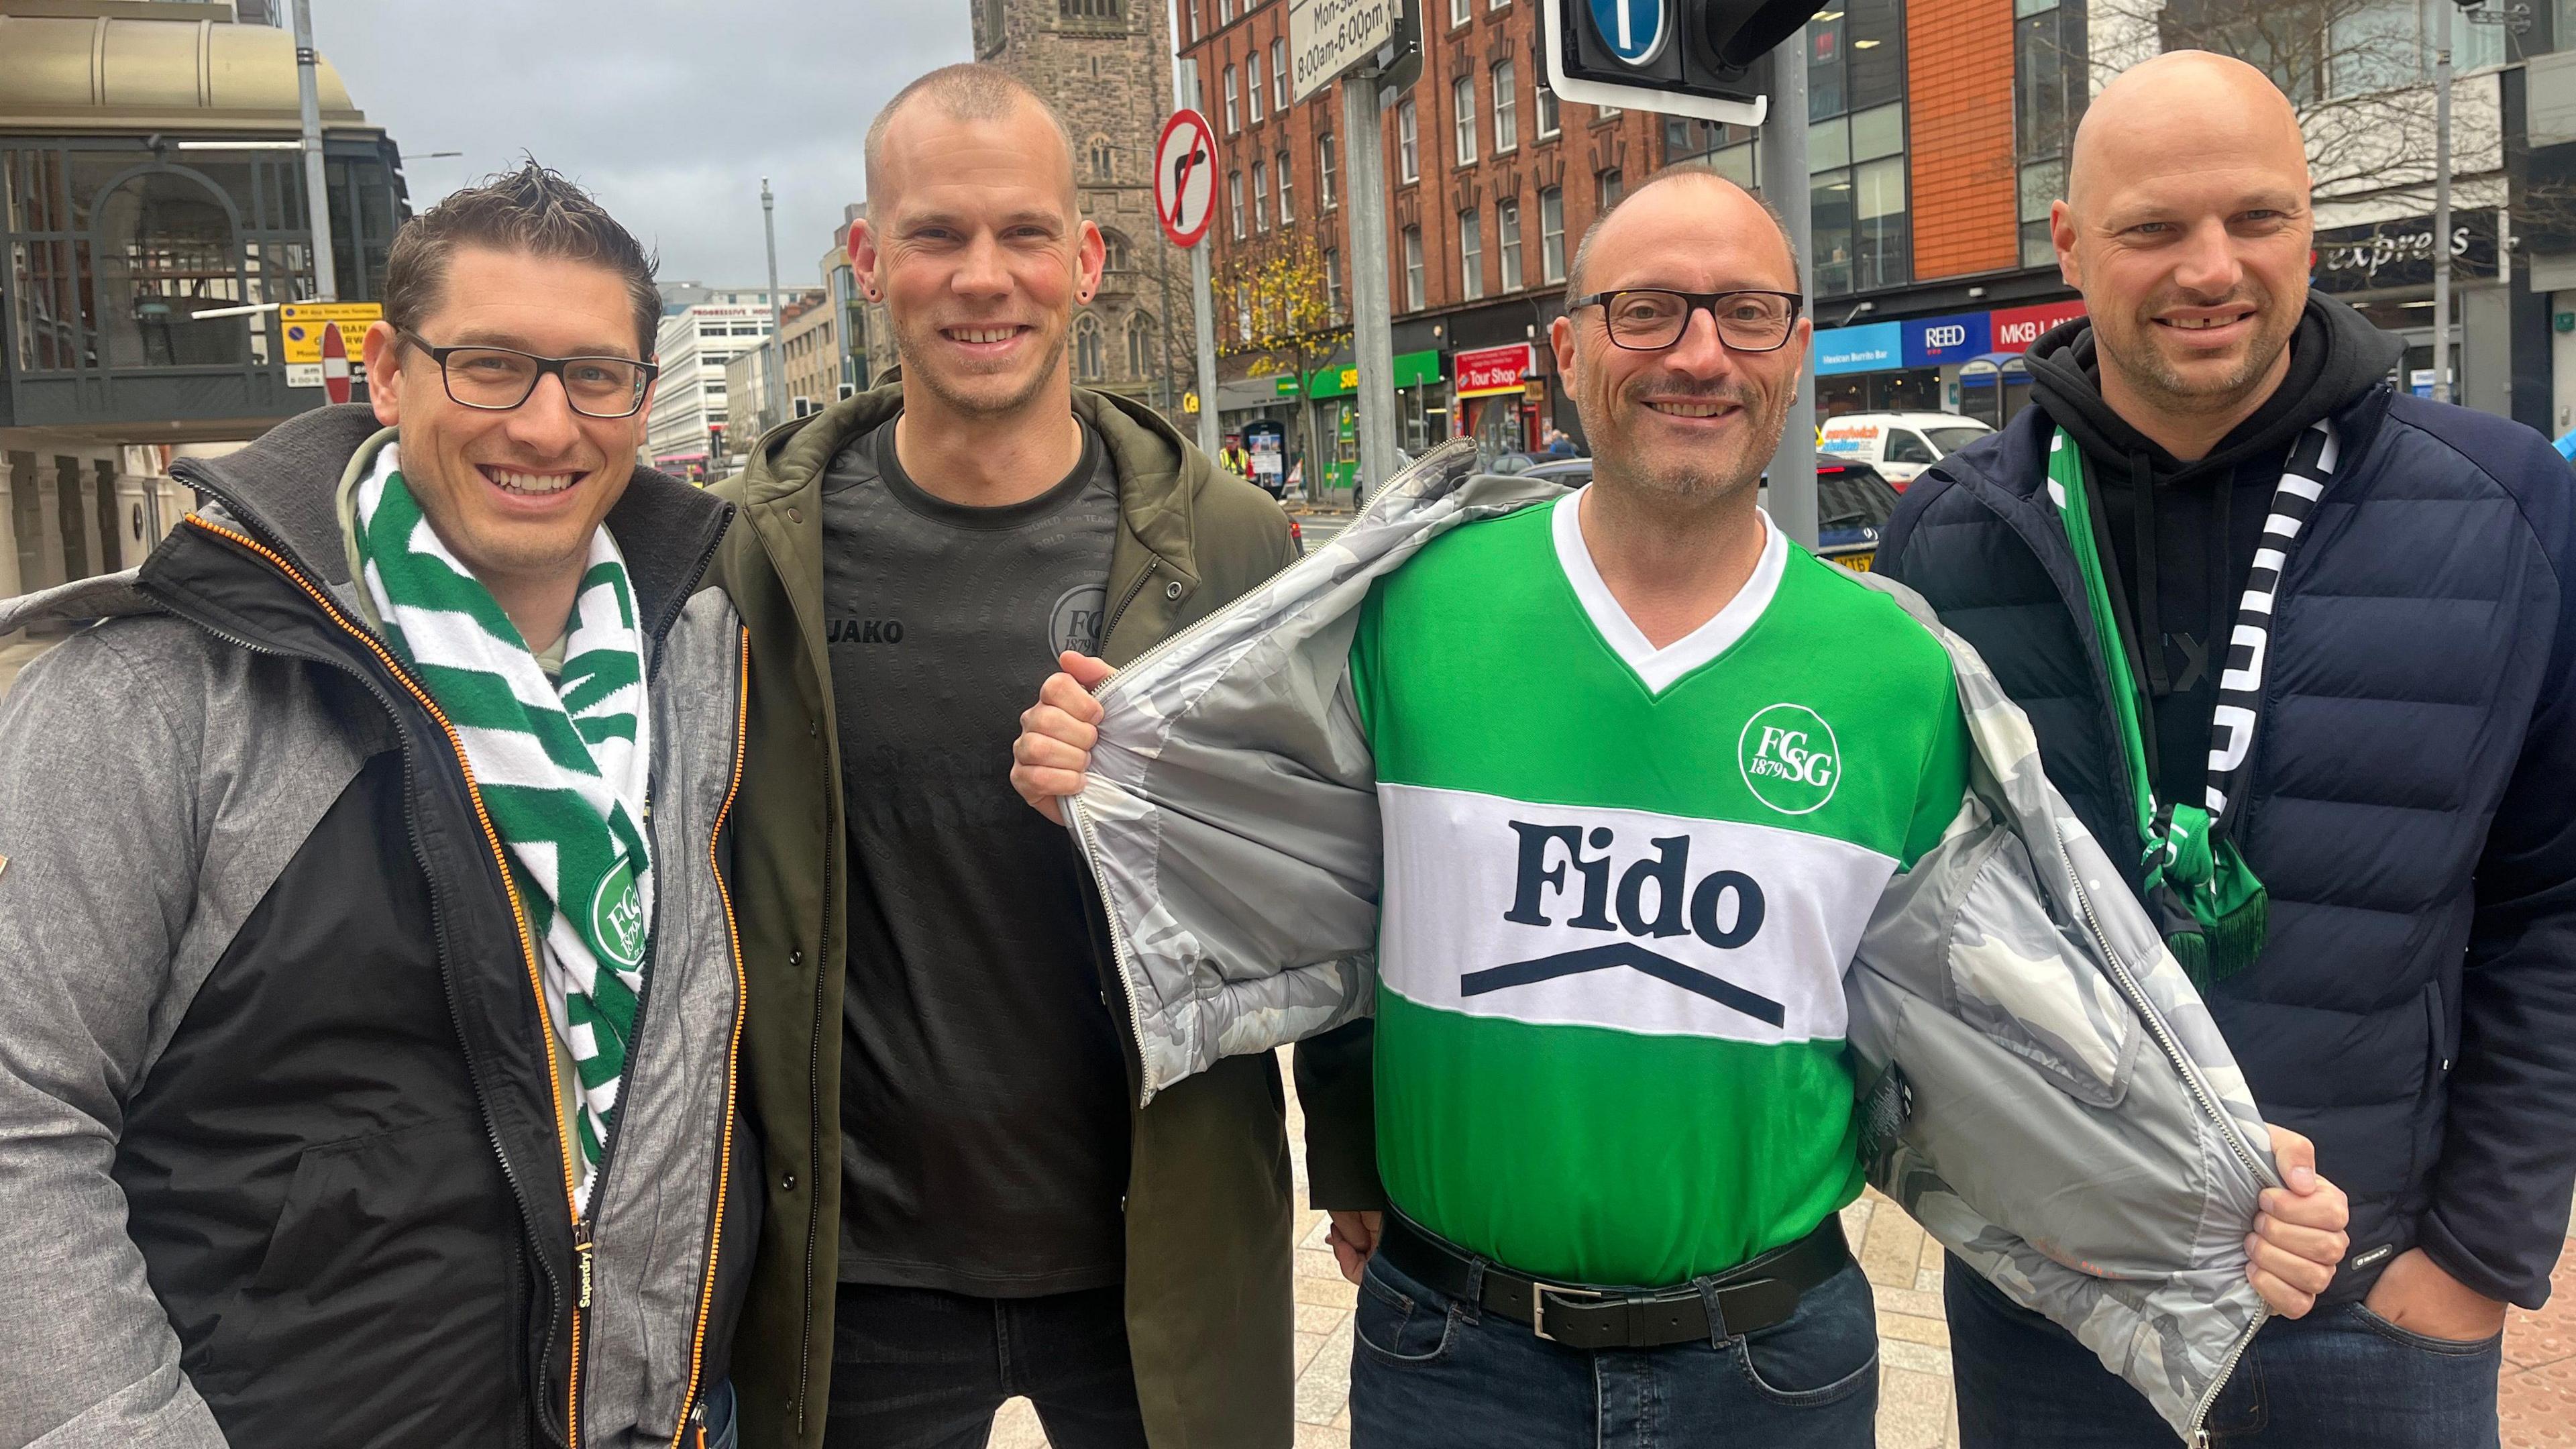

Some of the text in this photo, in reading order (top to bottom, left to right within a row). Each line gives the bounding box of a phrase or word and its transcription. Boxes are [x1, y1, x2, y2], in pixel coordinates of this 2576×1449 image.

[2327, 227, 2470, 277] expres
[1925, 325, 1965, 347] REED
[2000, 321, 2037, 344] MKB
[1823, 350, 1888, 364] Mexican Burrito Bar
[1469, 367, 1515, 387] Tour Shop
[827, 619, 904, 644] JAKO
[1748, 757, 1784, 777] 1879
[1504, 820, 1766, 949] Fido
[579, 1252, 592, 1308] Superdry
